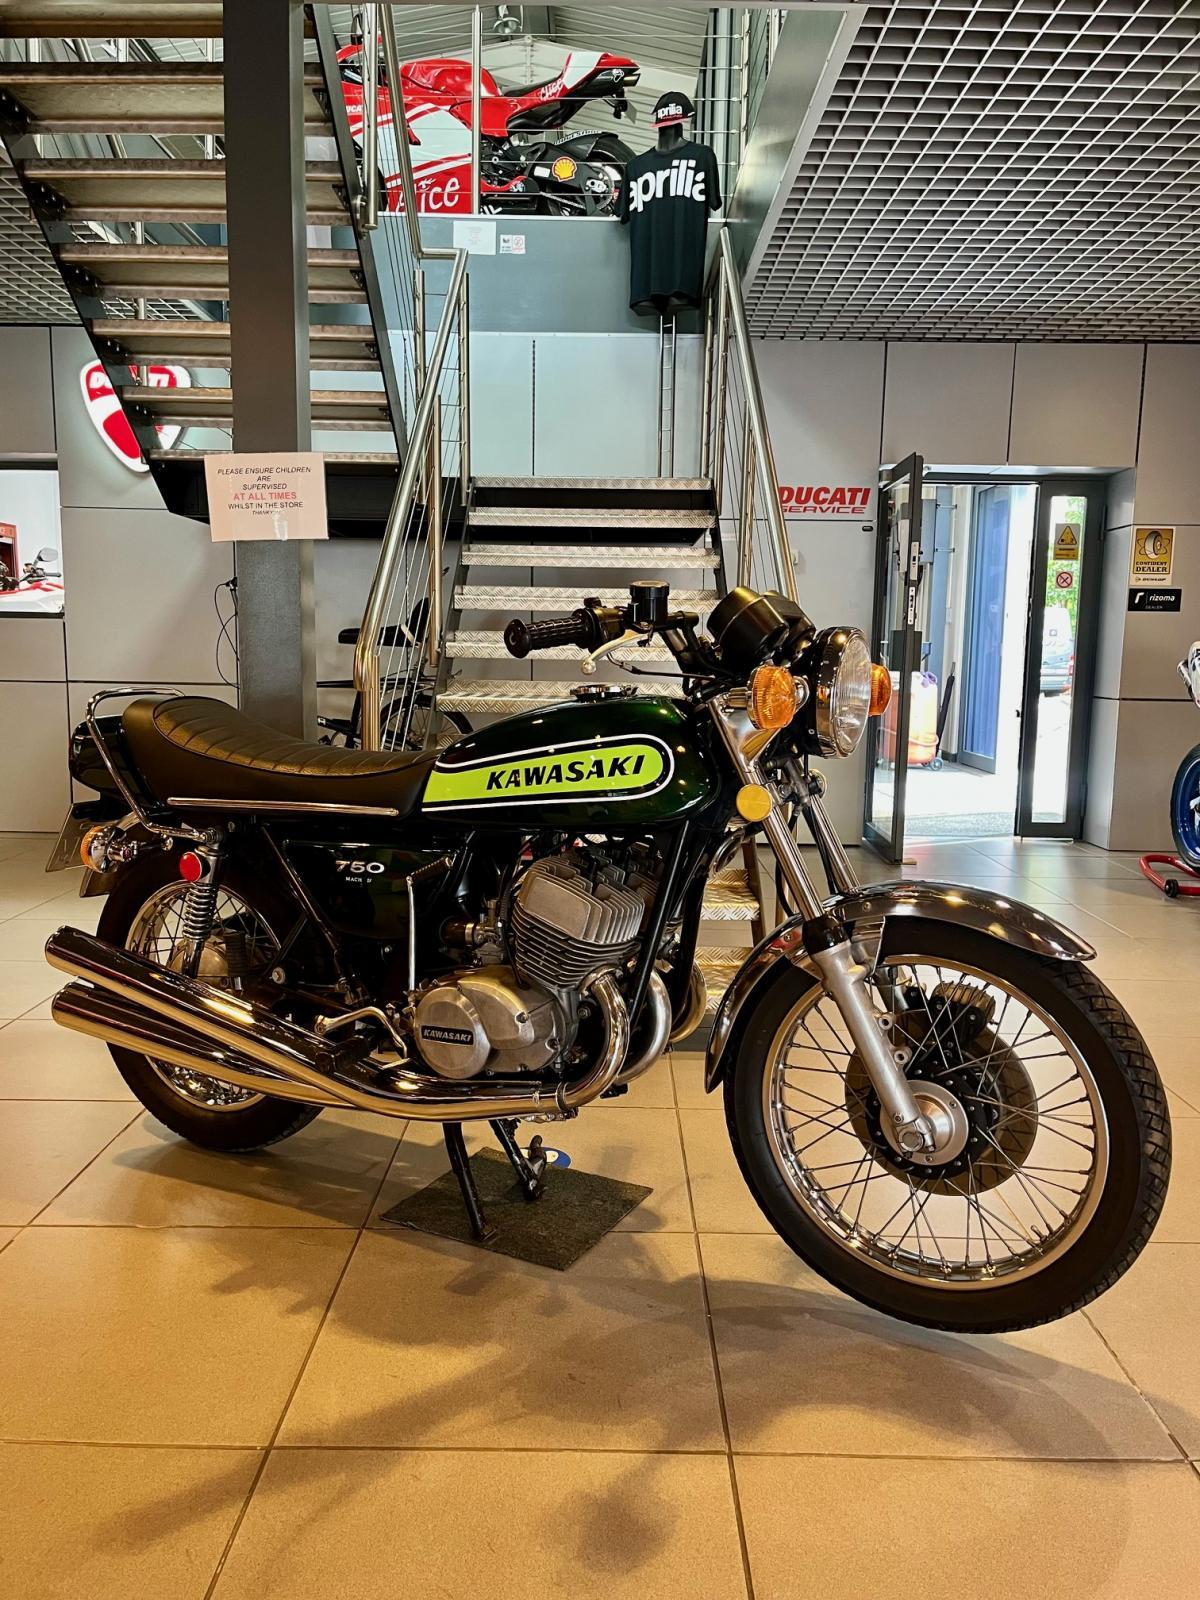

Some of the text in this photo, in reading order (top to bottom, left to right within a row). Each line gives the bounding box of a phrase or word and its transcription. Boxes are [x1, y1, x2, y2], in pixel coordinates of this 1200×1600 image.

[217, 467, 245, 475] PLEASE
[245, 467, 274, 475] ENSURE
[233, 491, 297, 501] AT ALL TIMES
[779, 487, 871, 506] DUCATI
[228, 502, 254, 510] WHILST
[1149, 593, 1176, 602] rizoma
[486, 754, 645, 791] KAWASAKI
[335, 860, 385, 873] 750
[423, 1029, 472, 1042] KAWASAKI
